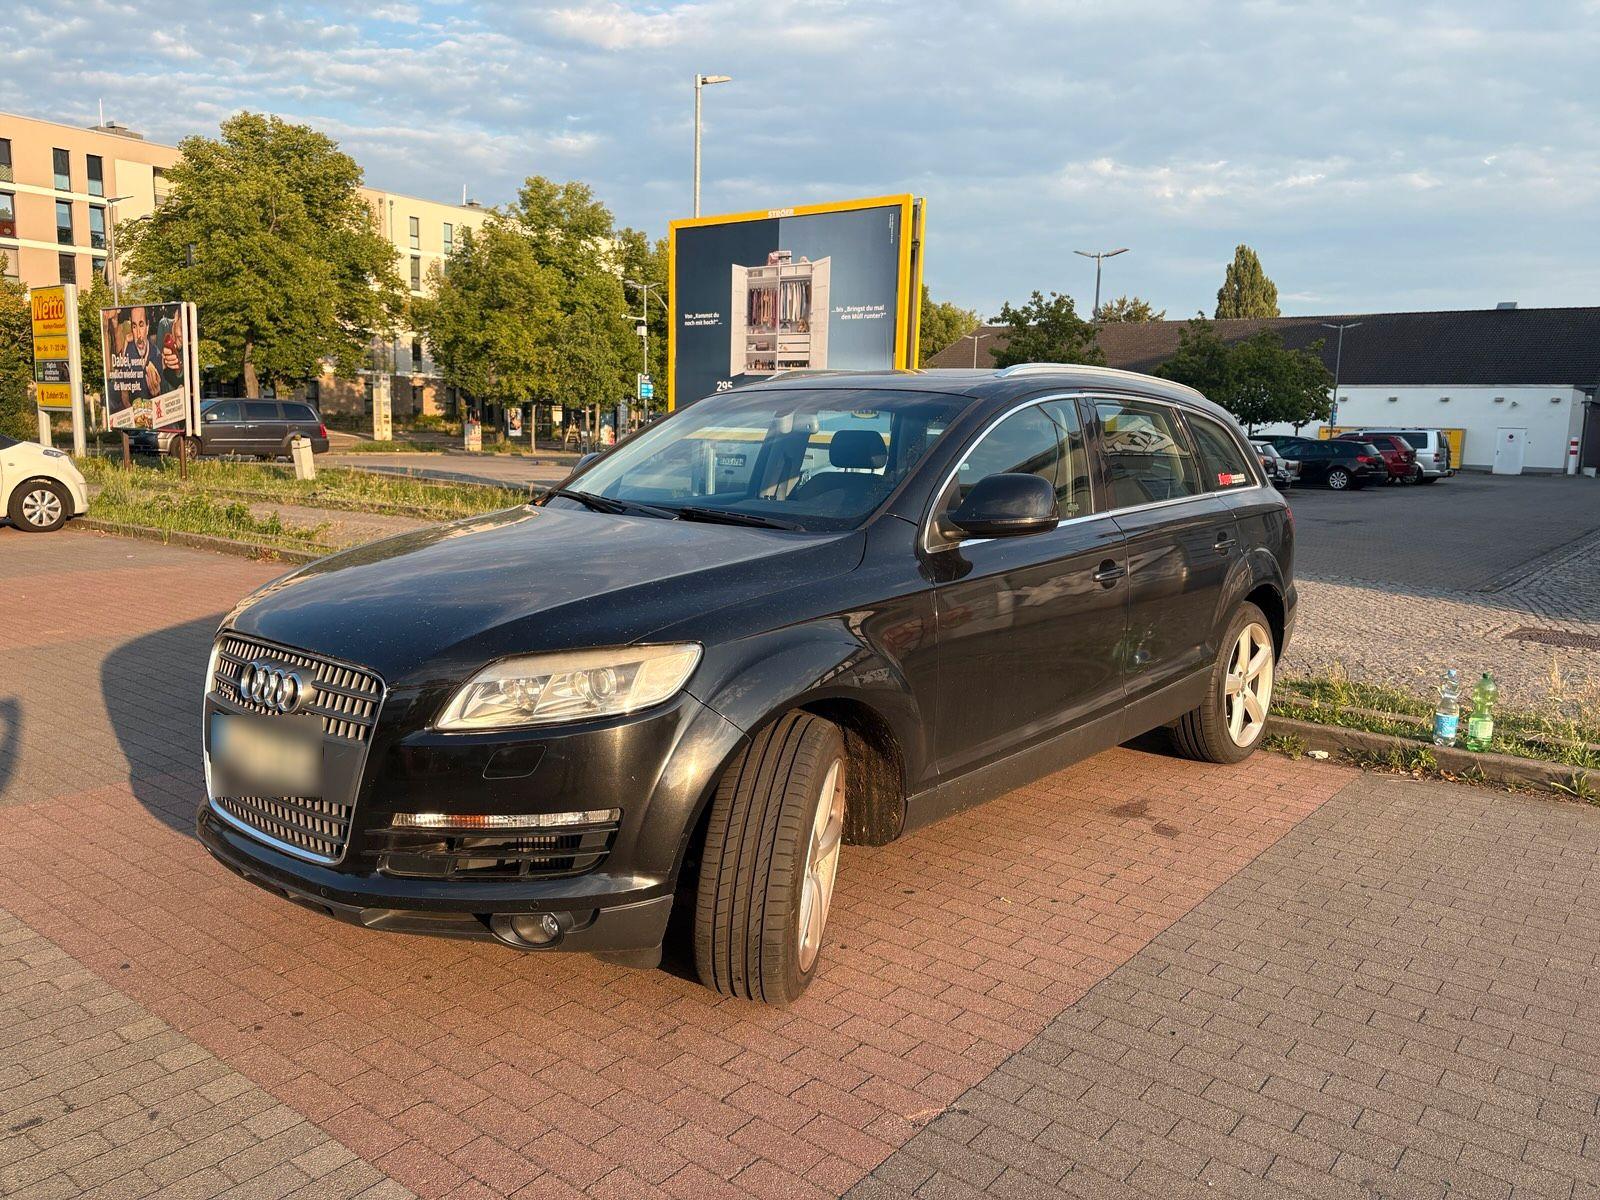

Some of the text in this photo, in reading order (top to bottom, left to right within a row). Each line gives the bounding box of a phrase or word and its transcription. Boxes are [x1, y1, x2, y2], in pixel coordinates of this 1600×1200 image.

[33, 295, 65, 320] Netto
[111, 353, 131, 369] Dabei,
[123, 369, 137, 378] wieder
[120, 382, 132, 391] Wurst
